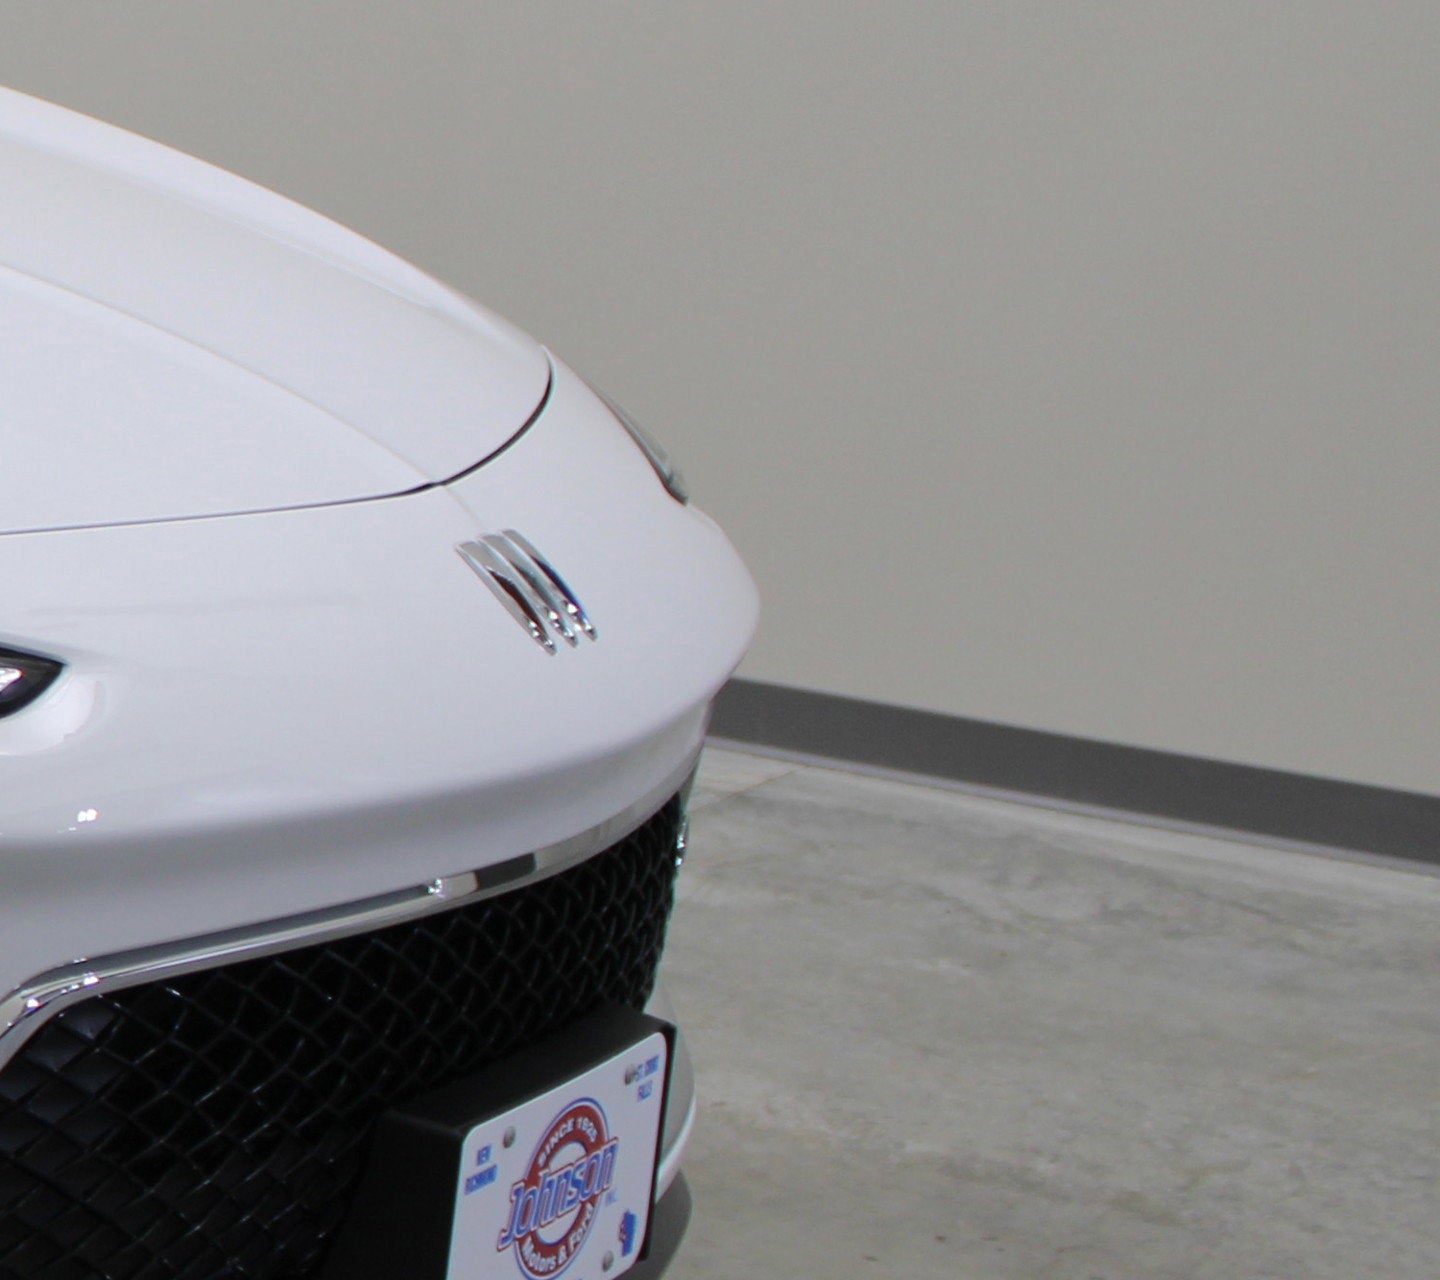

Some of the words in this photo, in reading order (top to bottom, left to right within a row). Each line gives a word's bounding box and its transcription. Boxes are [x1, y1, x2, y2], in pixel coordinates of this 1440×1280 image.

[537, 1116, 575, 1167] SINCE
[497, 1137, 618, 1252] Johnson
[521, 1234, 557, 1273] Motors
